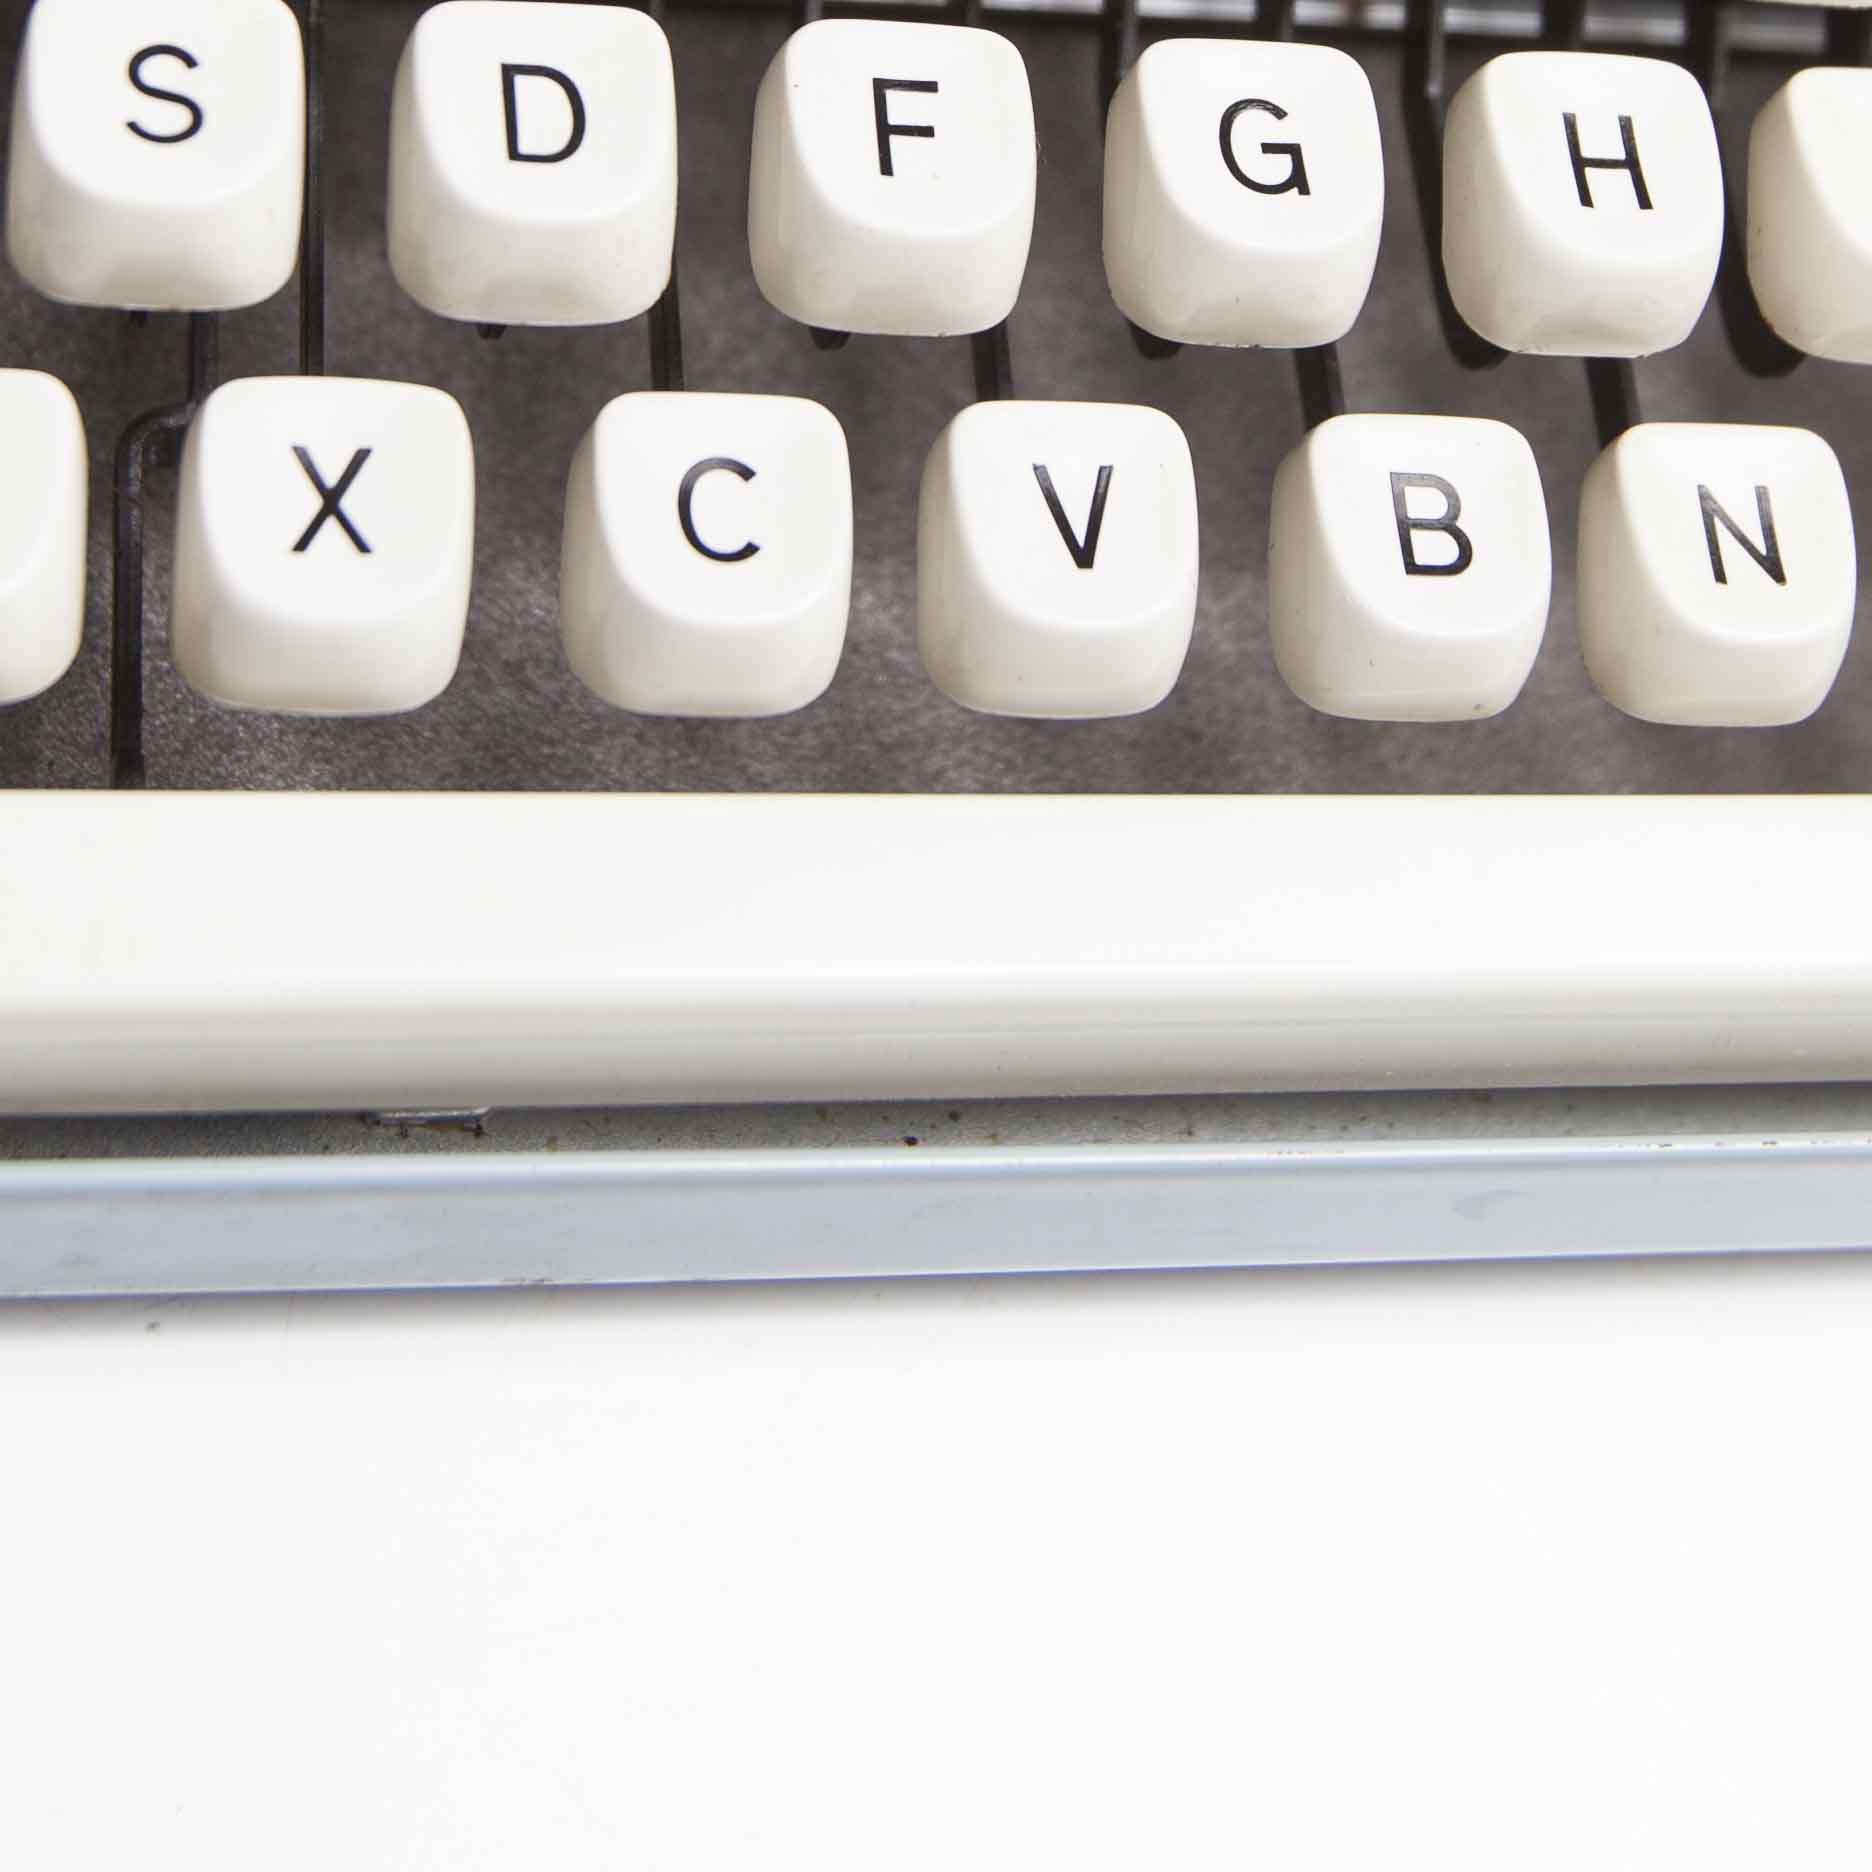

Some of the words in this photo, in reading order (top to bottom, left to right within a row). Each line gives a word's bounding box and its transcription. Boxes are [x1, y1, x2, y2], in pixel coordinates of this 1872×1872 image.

[126, 44, 204, 144] S
[501, 63, 586, 164] D
[872, 77, 939, 177] F
[1219, 98, 1311, 196] G
[1562, 113, 1653, 210] H
[292, 446, 372, 554] X
[677, 457, 760, 563] C
[1033, 464, 1113, 569] V
[1390, 472, 1473, 577] B
[1698, 485, 1787, 586] N
